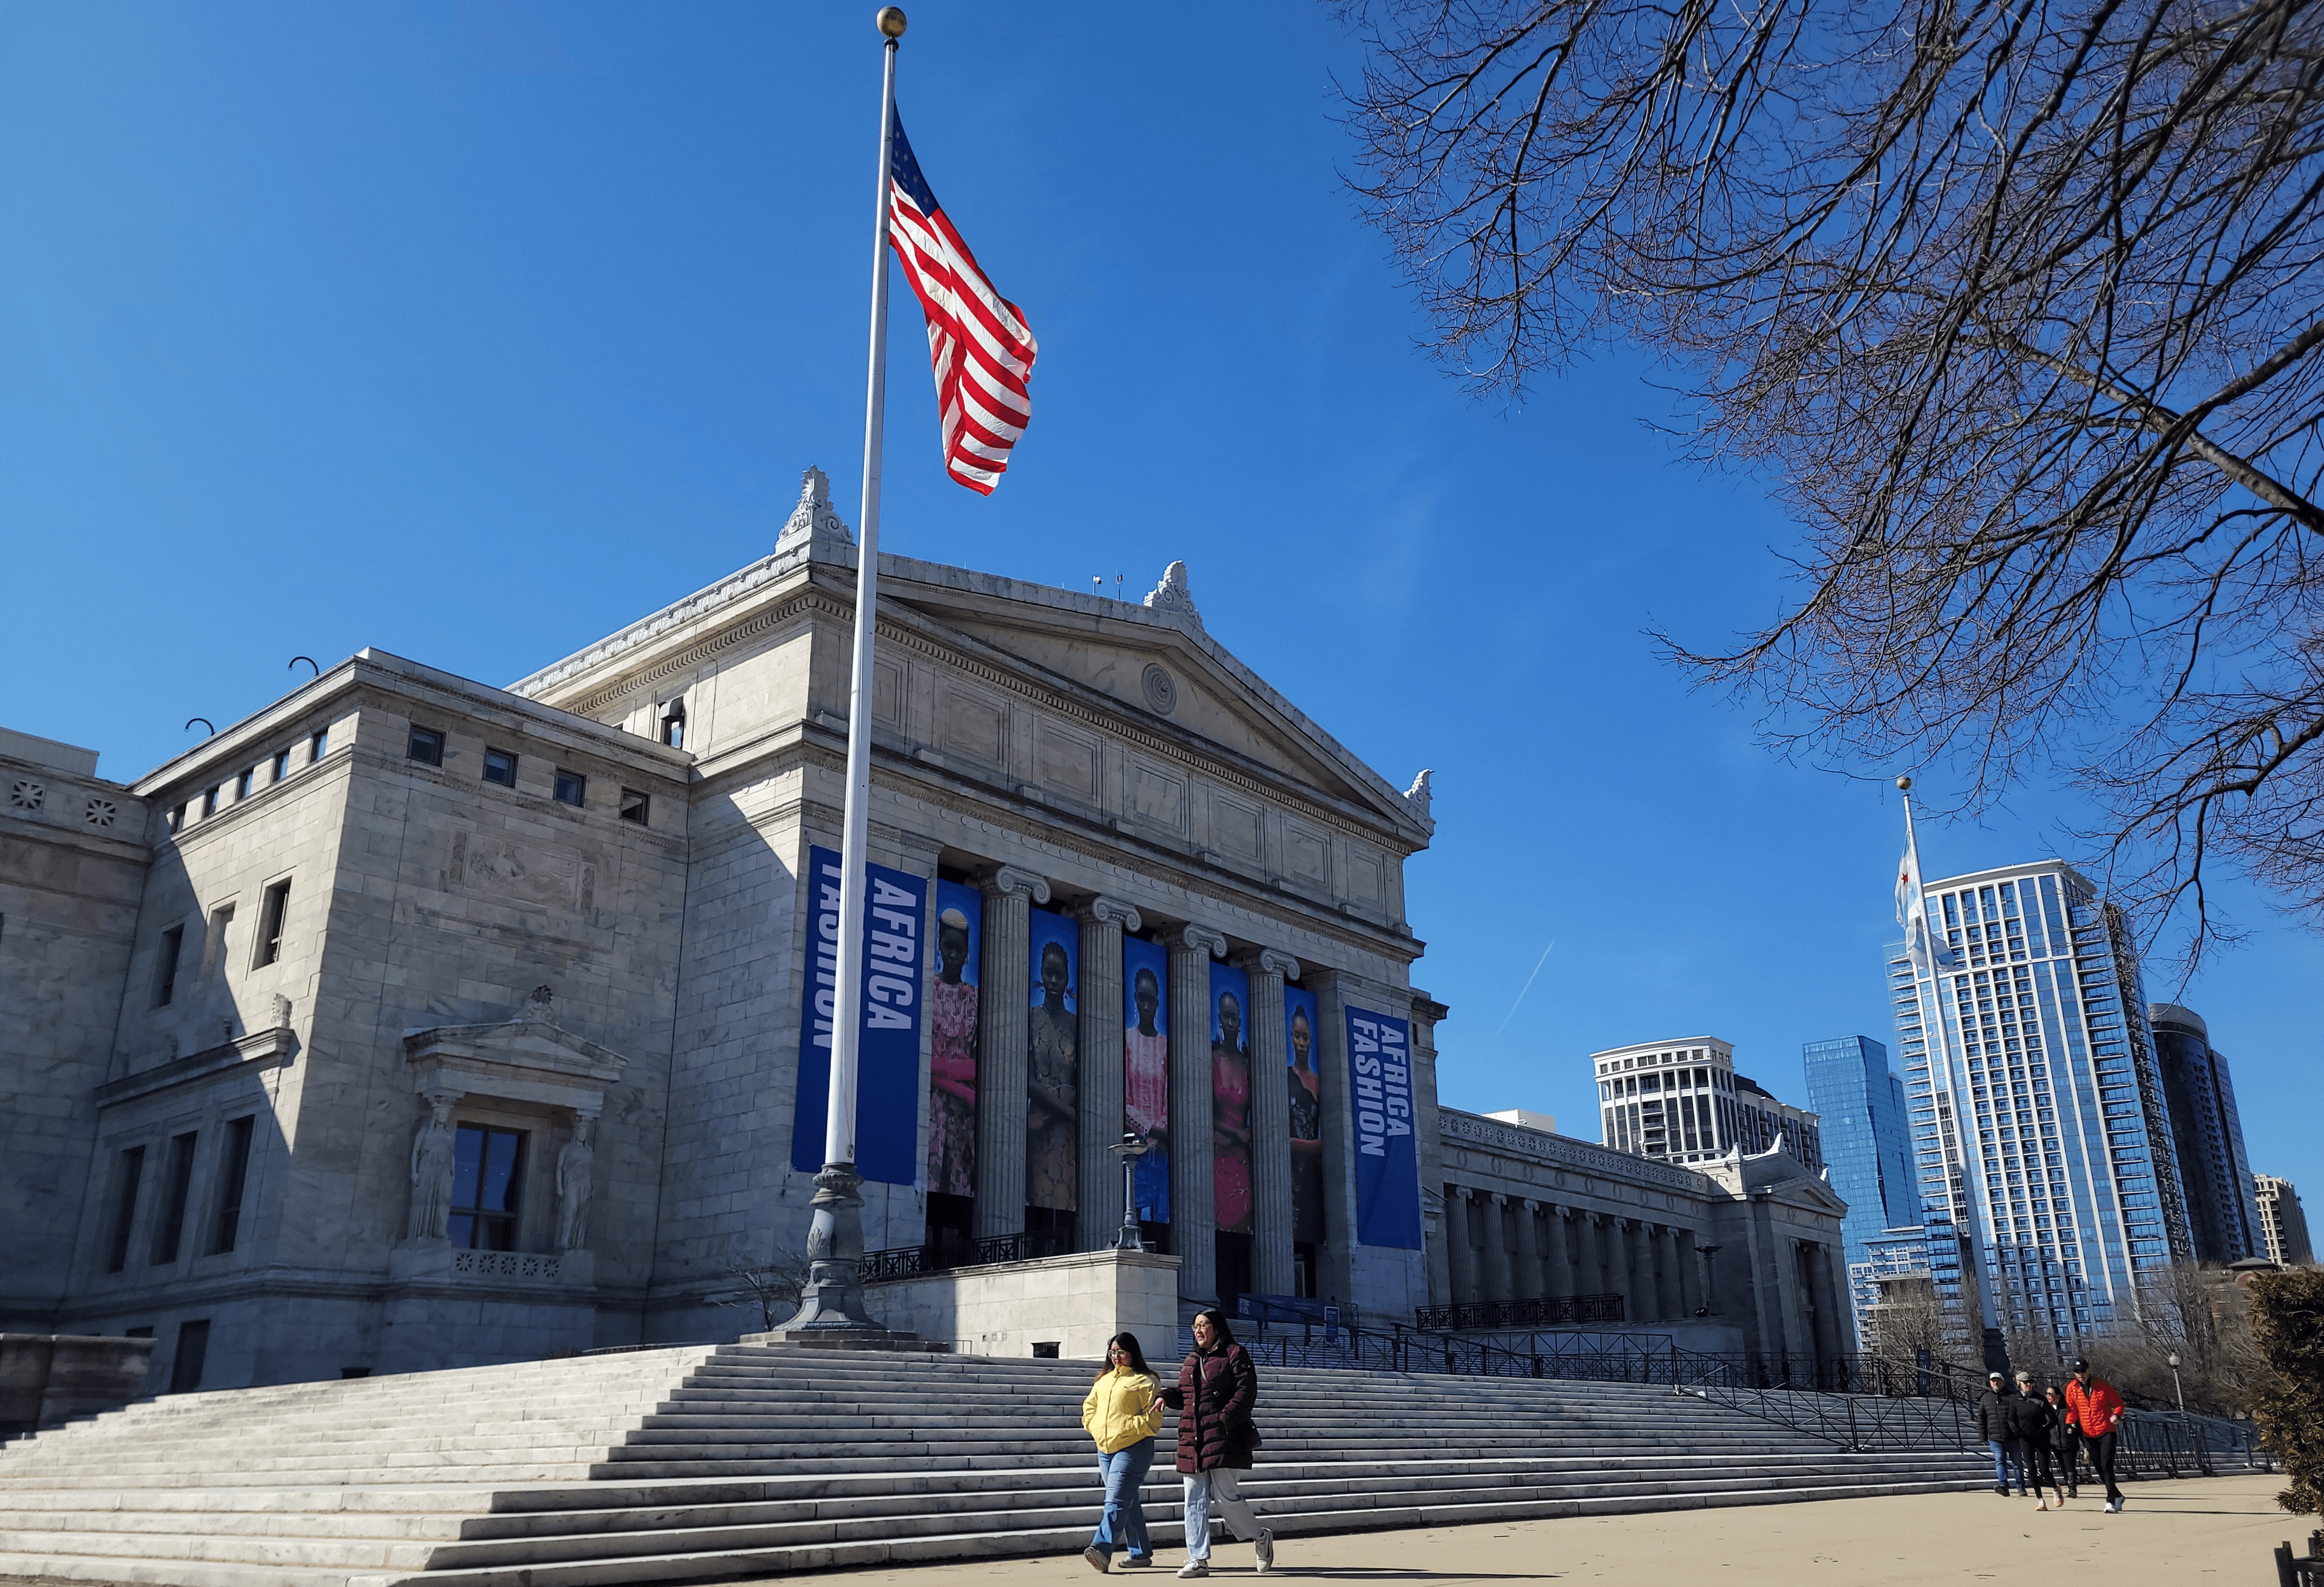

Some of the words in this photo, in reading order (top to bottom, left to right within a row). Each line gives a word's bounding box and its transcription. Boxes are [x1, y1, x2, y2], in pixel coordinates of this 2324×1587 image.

[867, 877, 917, 1030] AFRICA
[1353, 1017, 1385, 1157] FASHION
[1380, 1024, 1411, 1136] AFRICA
